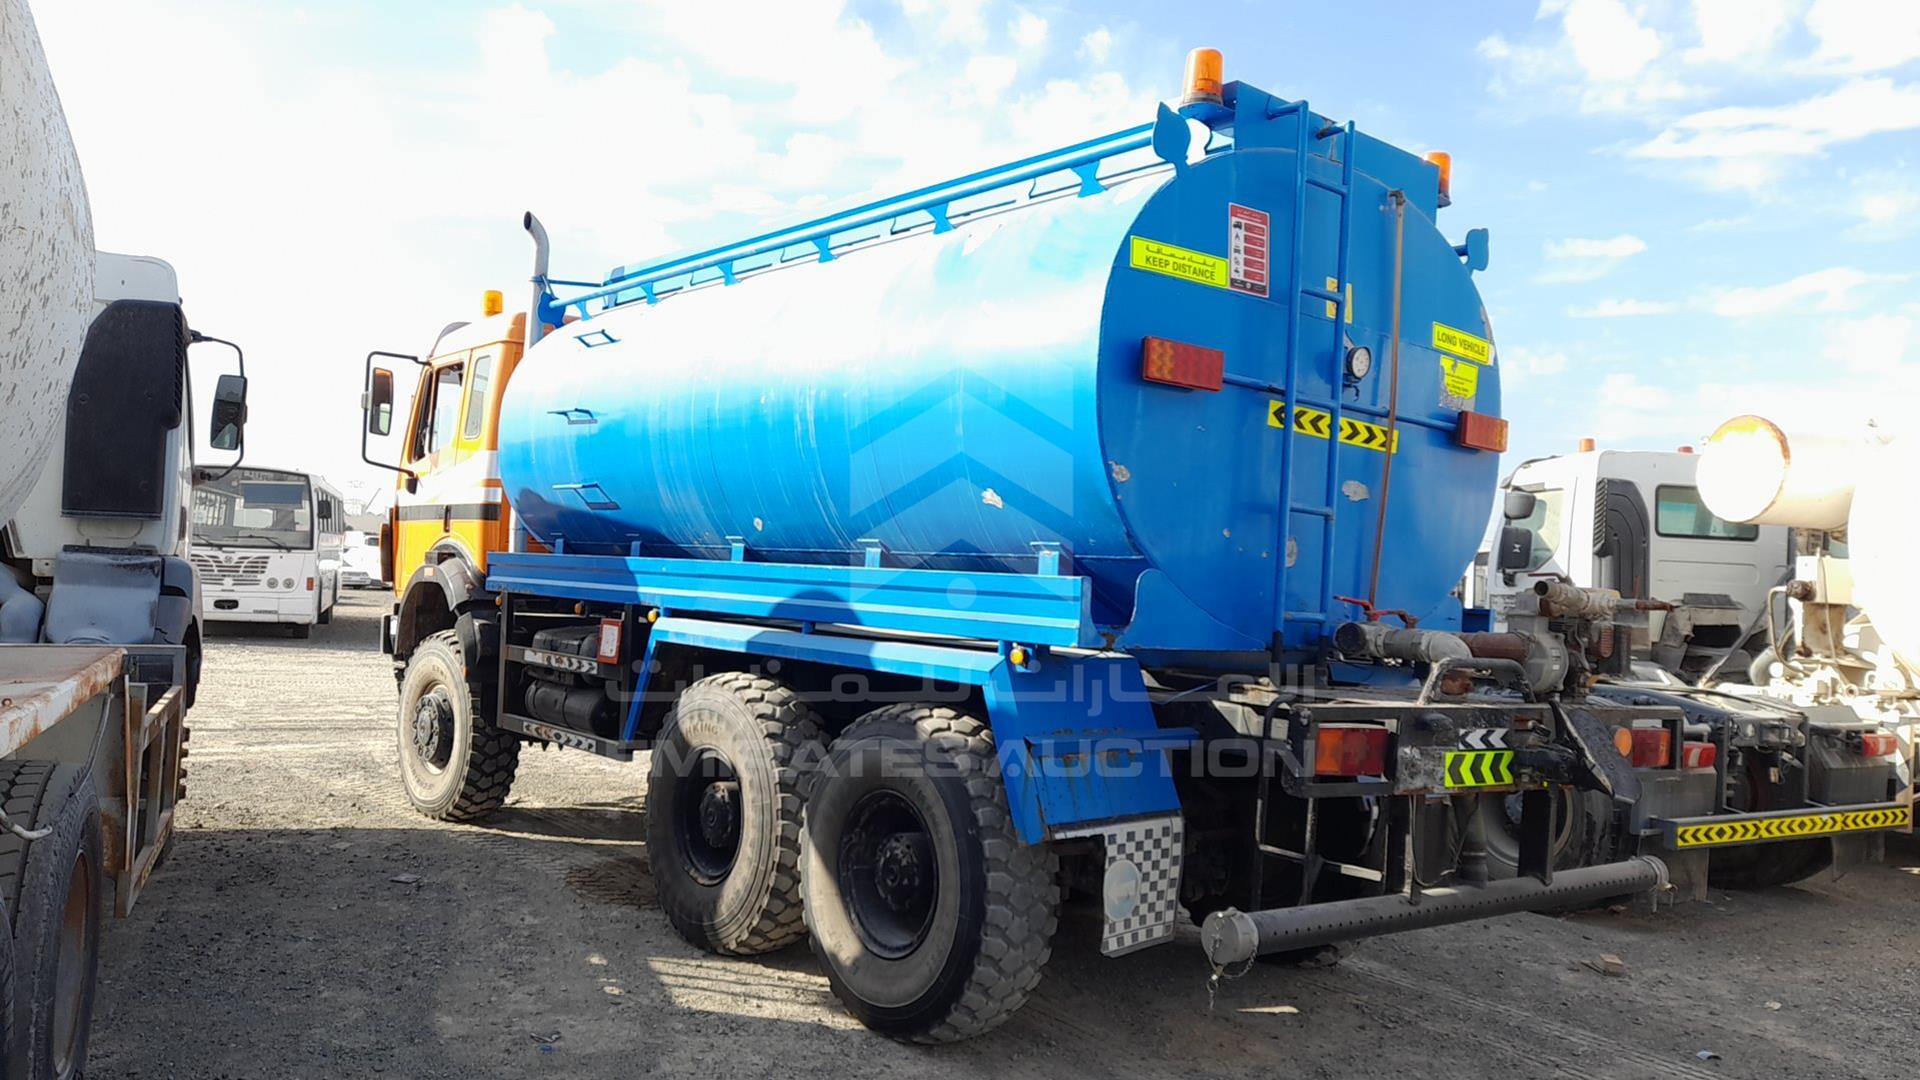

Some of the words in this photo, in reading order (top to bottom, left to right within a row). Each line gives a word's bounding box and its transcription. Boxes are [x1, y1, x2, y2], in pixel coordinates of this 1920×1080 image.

[1145, 255, 1170, 268] KEEP
[1172, 261, 1216, 281] DISTANCE
[1437, 330, 1458, 346] LONG
[1459, 338, 1486, 357] VEHICLE
